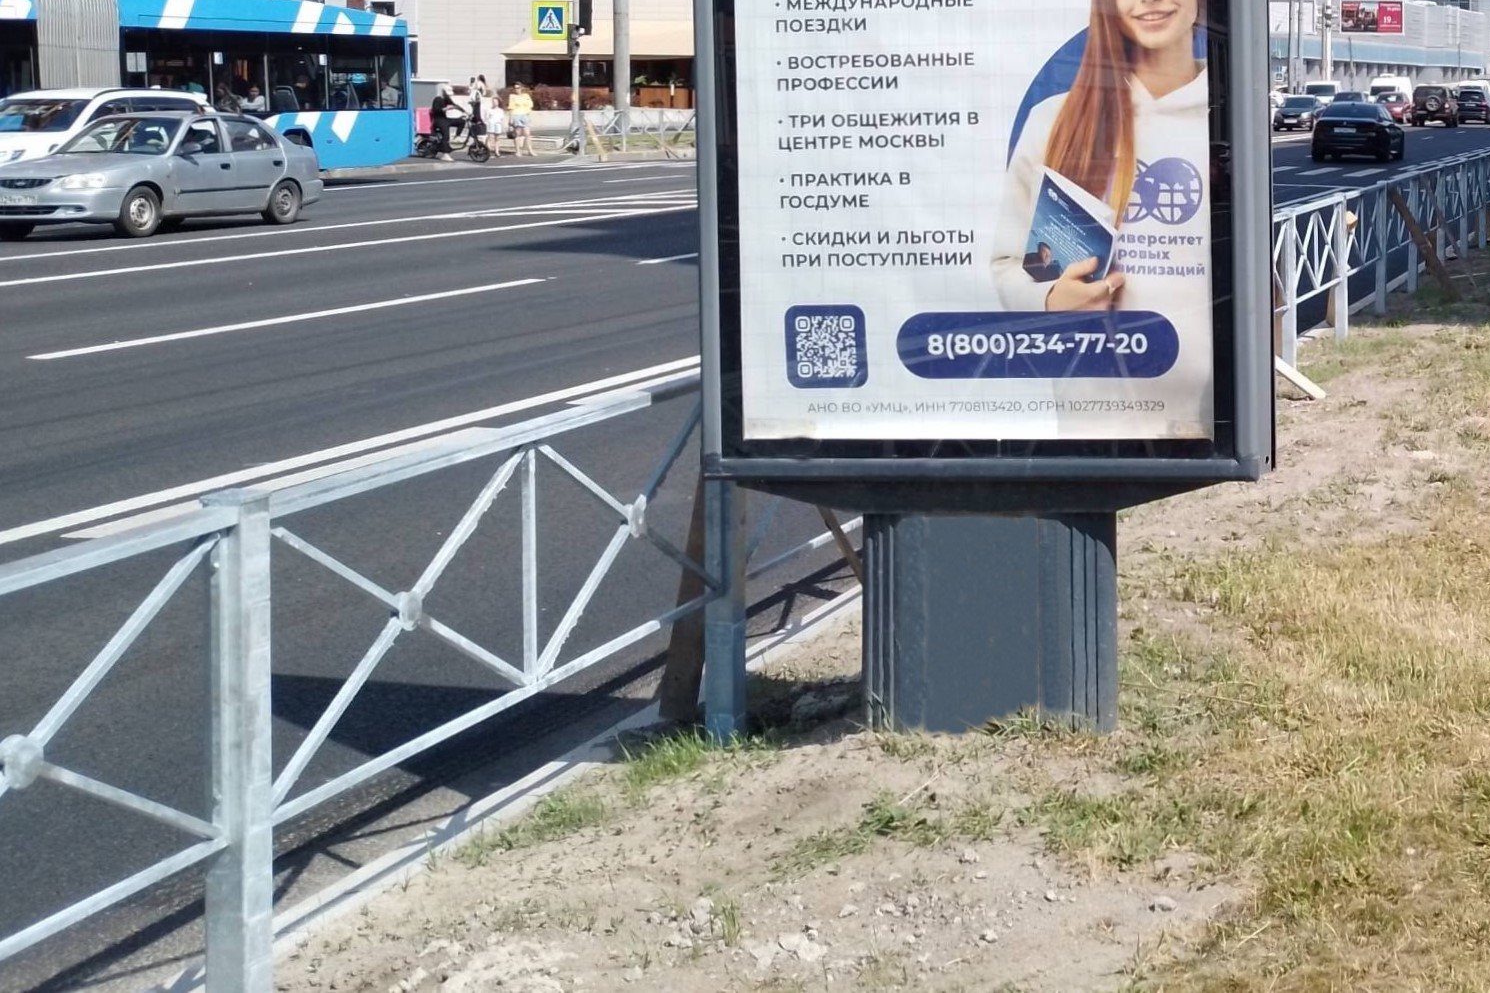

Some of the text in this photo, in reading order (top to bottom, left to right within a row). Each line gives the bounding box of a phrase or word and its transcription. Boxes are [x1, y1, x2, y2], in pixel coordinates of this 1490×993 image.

[776, 18, 866, 34] ПОЕЗДКИ
[788, 53, 974, 69] ВОСТРЕБОВАННЫЕ
[778, 76, 898, 91] ПРОФЕССИИ
[788, 112, 979, 129] ТРИ ОБЩЕЖИТИЯ В
[779, 134, 944, 152] ЦЕНТРЕ МОСКВЫ
[791, 172, 910, 187] ПРАКТИКА В
[780, 195, 869, 210] ГОСДУМЕ
[793, 230, 974, 247] СКИДКИ И ЛЬГОТЫ
[1117, 234, 1203, 246] иверситет
[782, 252, 972, 267] ПРИ ПОСТУПЛЕНИИ
[928, 333, 1147, 359] 8(800)234-77-20
[808, 403, 838, 413] АНО
[842, 403, 862, 413] ВО
[915, 402, 946, 412] ИНН
[1027, 401, 1065, 412] ОГРН
[1069, 400, 1165, 412] 1027739349329
